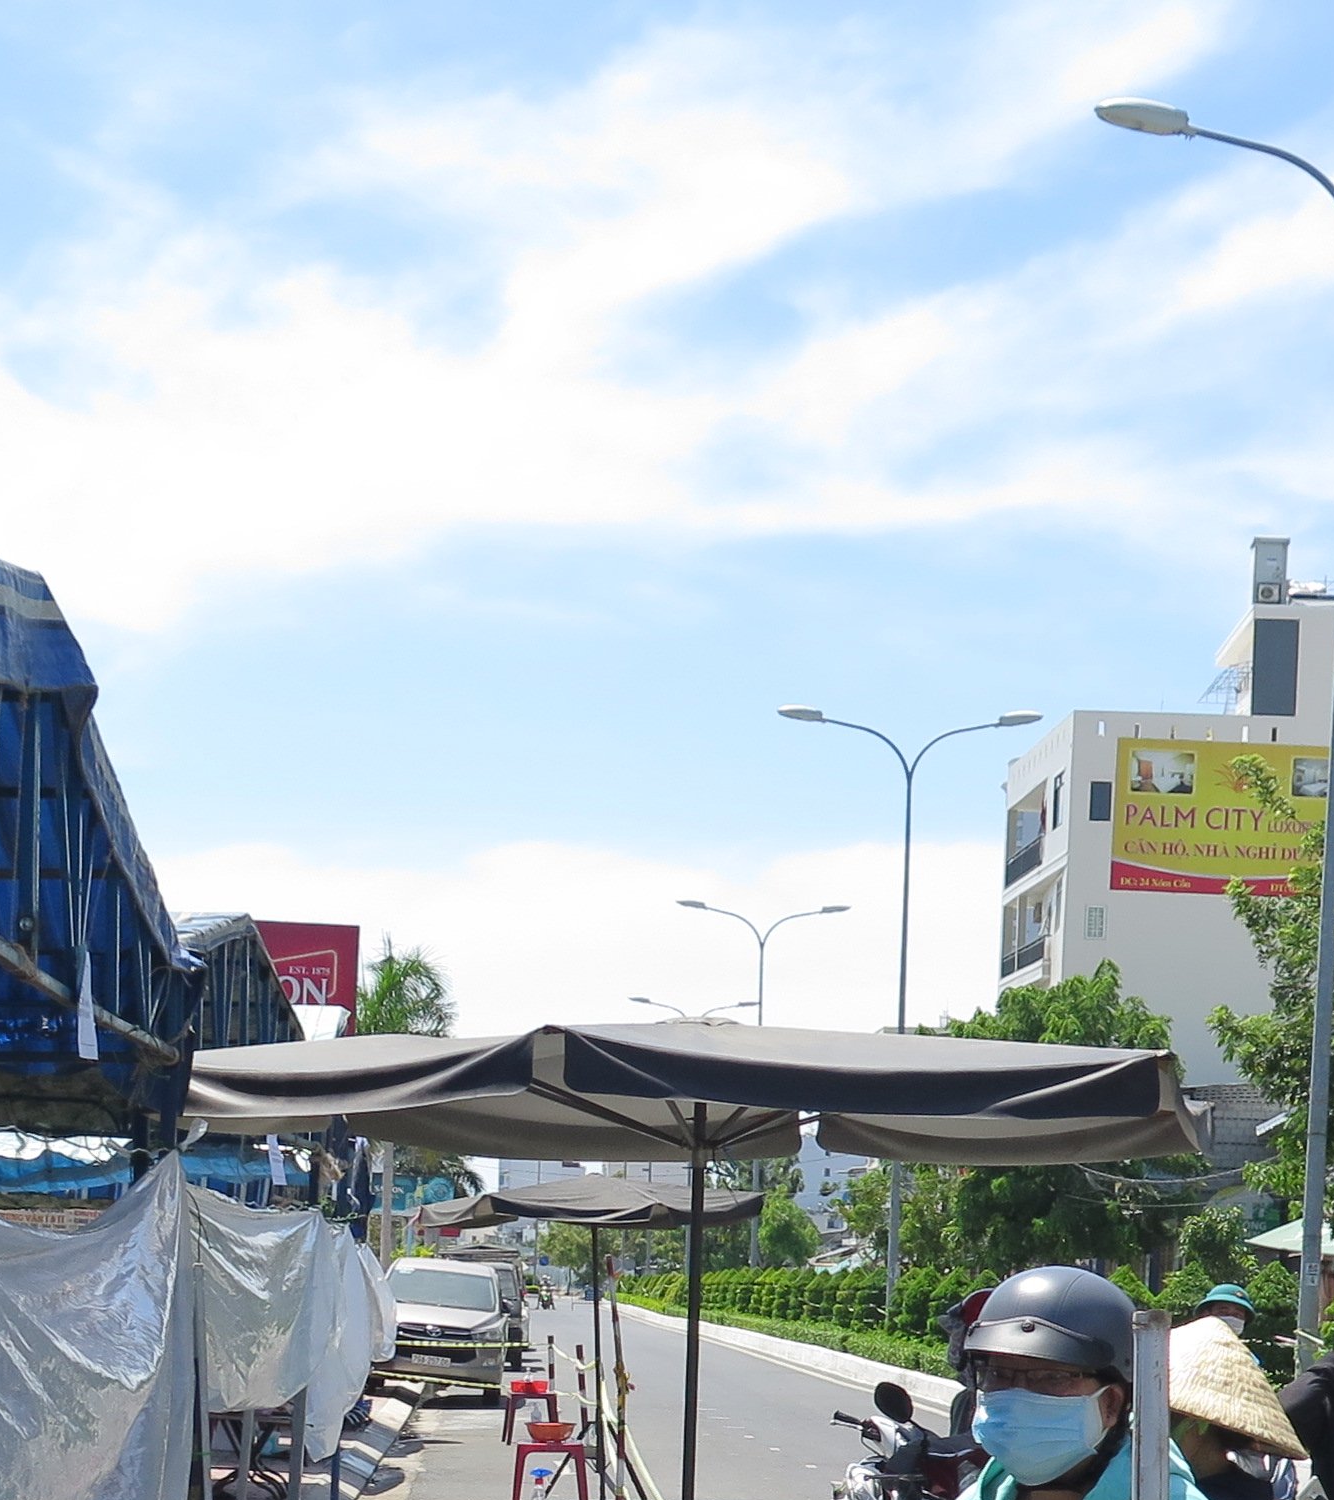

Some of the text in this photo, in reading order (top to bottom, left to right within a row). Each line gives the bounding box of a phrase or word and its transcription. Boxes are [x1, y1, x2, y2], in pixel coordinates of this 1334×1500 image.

[1125, 804, 1196, 829] PALM
[1205, 807, 1265, 832] CITY
[1194, 842, 1229, 859] NHÀ
[1235, 843, 1276, 860] NGHỈ
[289, 965, 308, 975] EST.
